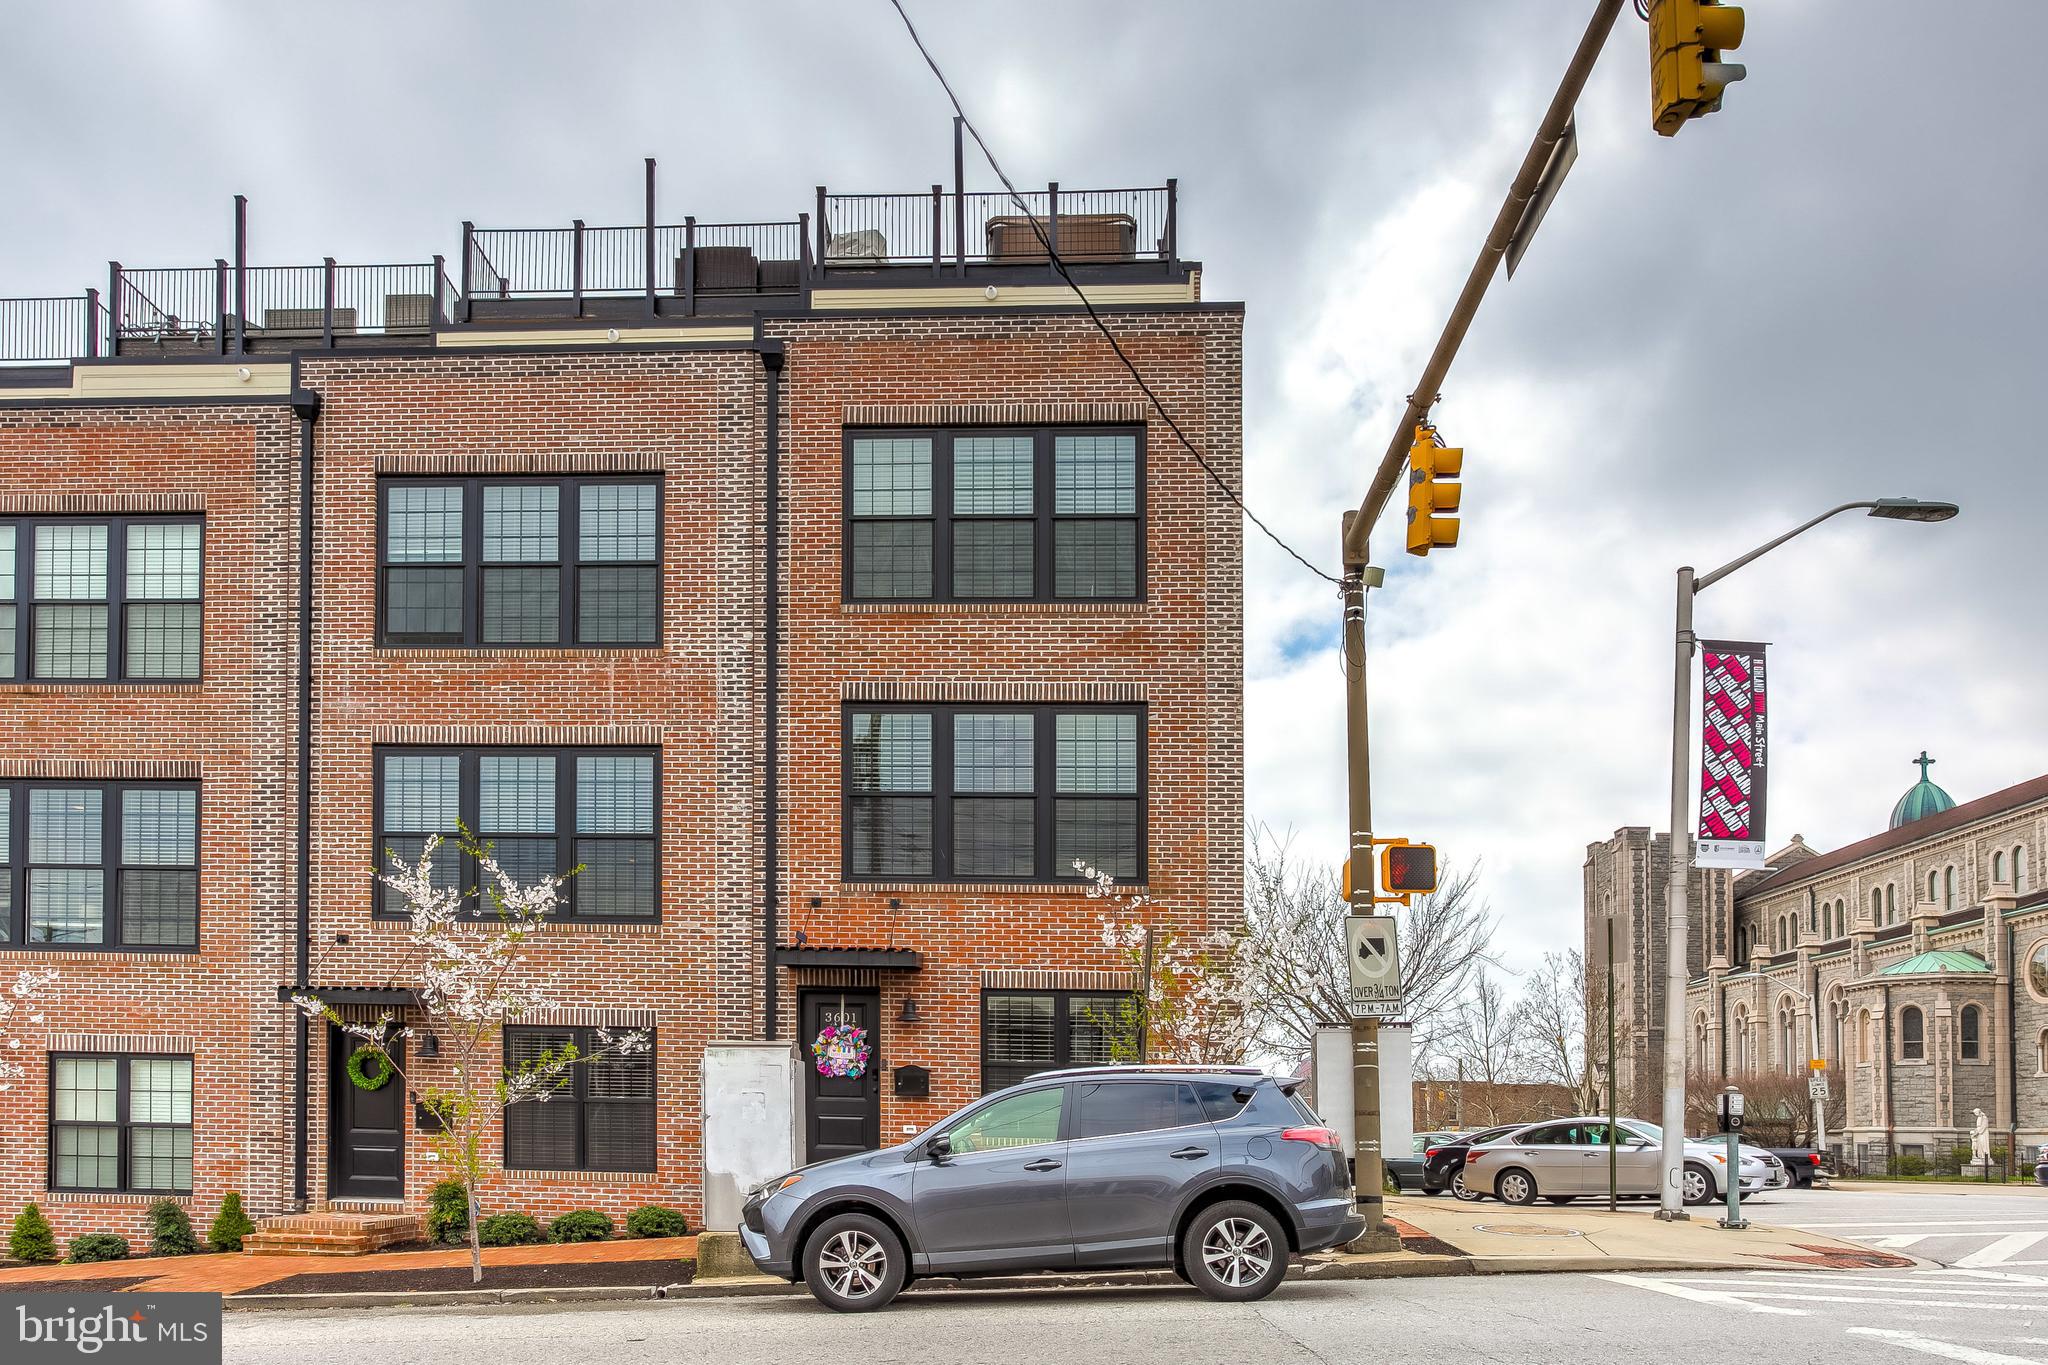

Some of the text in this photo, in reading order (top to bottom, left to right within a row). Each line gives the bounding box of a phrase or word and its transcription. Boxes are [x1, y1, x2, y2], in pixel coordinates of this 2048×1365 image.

[1755, 714, 1765, 735] Main
[1753, 737, 1765, 768] Street
[1354, 986, 1373, 998] OVER
[1384, 985, 1399, 997] TON
[825, 1012, 857, 1022] 3601
[1812, 1087, 1826, 1095] 25
